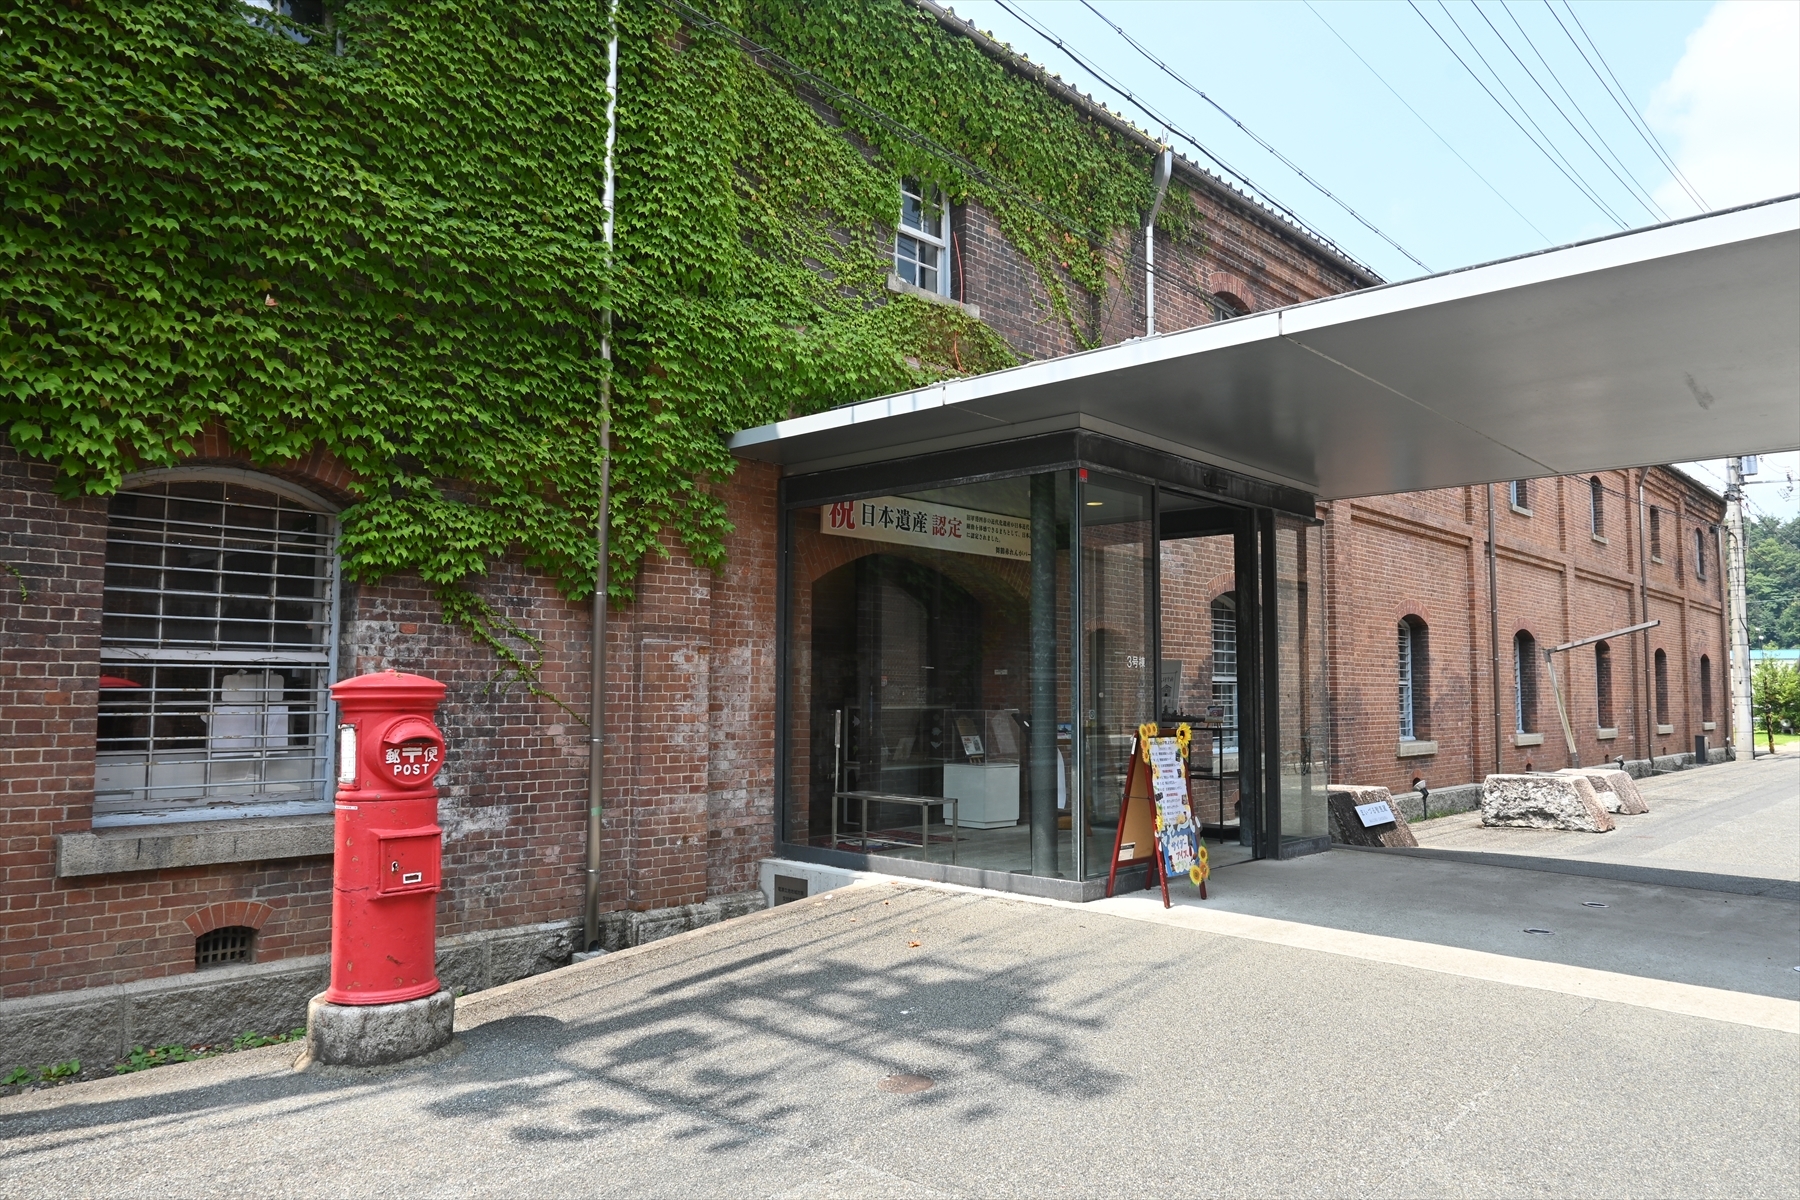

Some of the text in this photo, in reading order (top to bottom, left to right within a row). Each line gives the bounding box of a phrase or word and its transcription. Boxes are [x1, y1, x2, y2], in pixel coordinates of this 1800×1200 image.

[828, 501, 963, 538] 祝 日本遺産 認定
[1126, 655, 1146, 668] 3号棟
[393, 763, 429, 776] POST
[1171, 838, 1187, 851] サイダー
[1176, 849, 1189, 860] アイス
